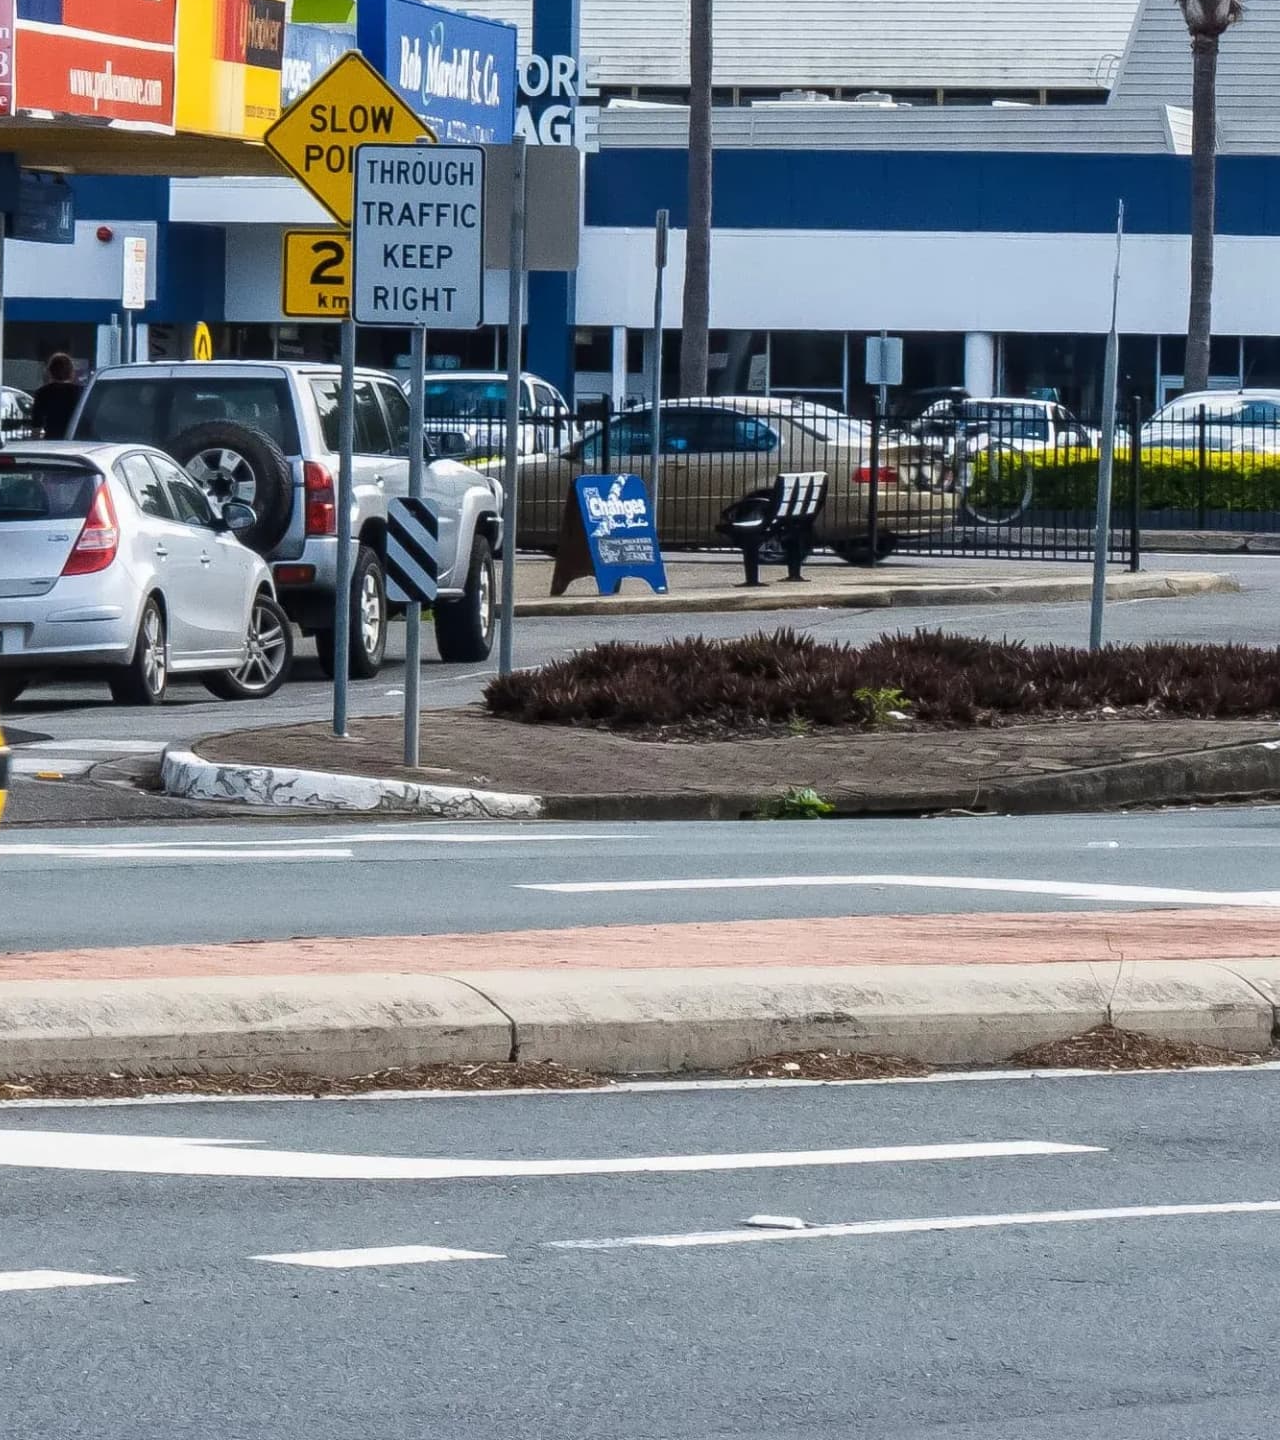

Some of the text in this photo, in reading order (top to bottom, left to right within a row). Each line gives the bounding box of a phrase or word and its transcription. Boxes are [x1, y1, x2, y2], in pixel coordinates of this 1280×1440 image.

[517, 53, 601, 97] ORE
[309, 104, 395, 134] SLOW
[514, 105, 601, 153] AGE
[304, 144, 354, 173] POI
[366, 159, 475, 187] THROUGH
[361, 200, 477, 229] TRAFFIC
[309, 240, 346, 286] 2
[383, 243, 454, 270] KEEP
[317, 292, 350, 309] km
[373, 285, 458, 313] RIGHT
